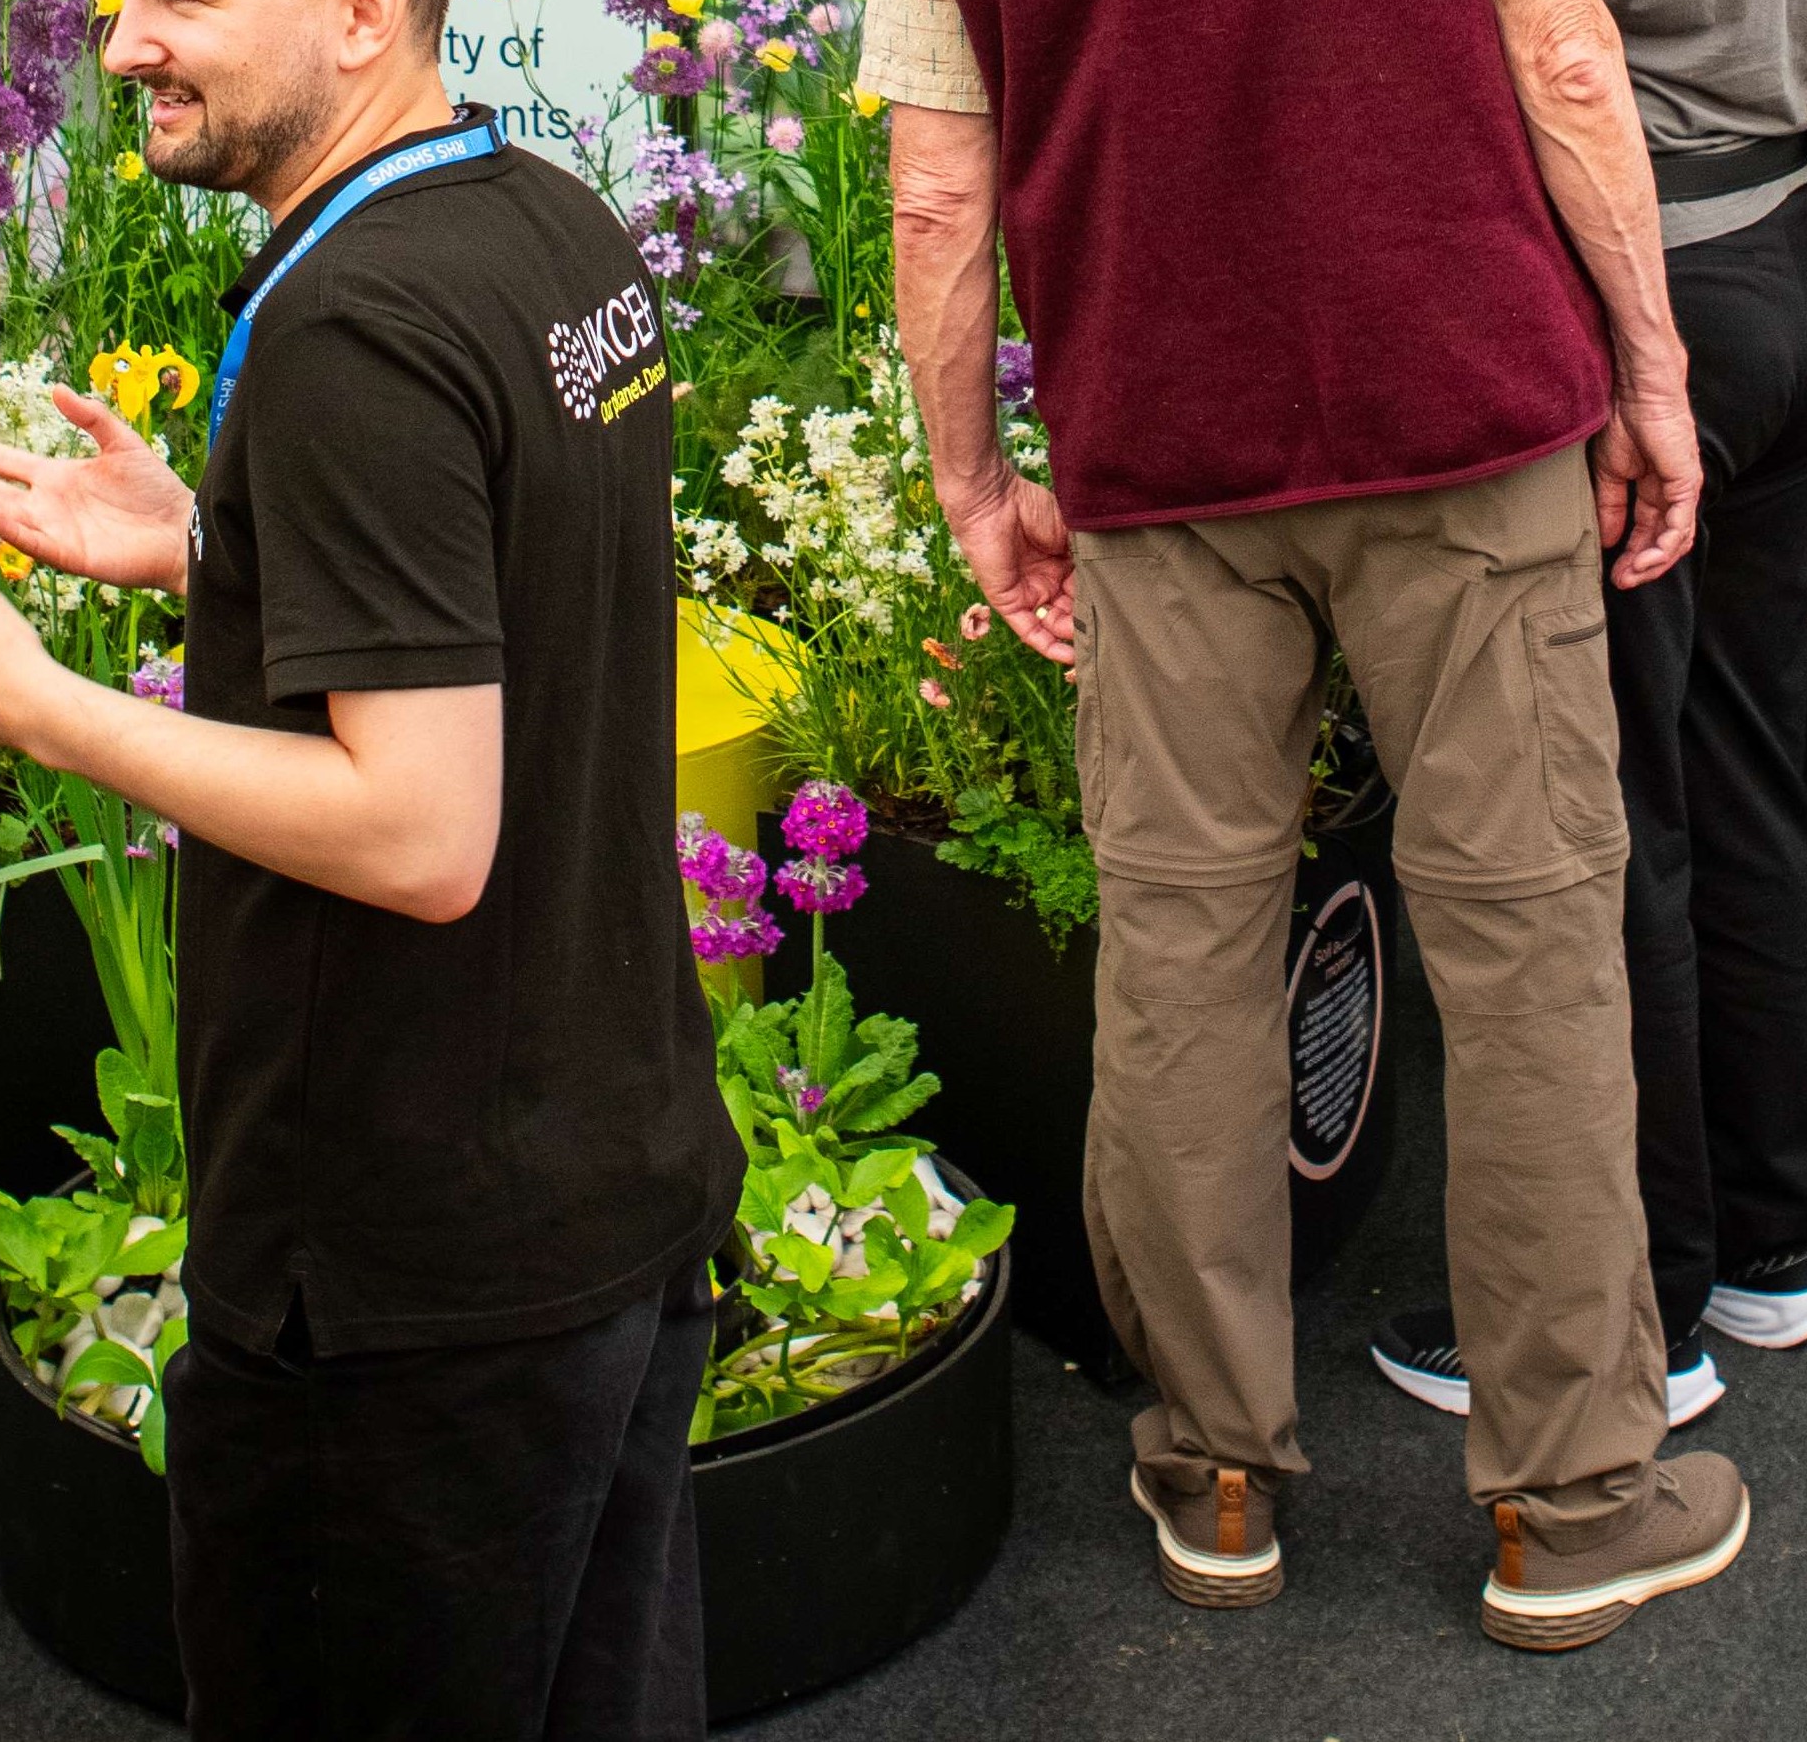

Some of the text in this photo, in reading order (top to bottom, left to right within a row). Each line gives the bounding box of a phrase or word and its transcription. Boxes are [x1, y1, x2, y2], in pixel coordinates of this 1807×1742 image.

[499, 27, 544, 69] of
[366, 138, 468, 189] RHS SHOWS
[288, 226, 318, 262] RHS
